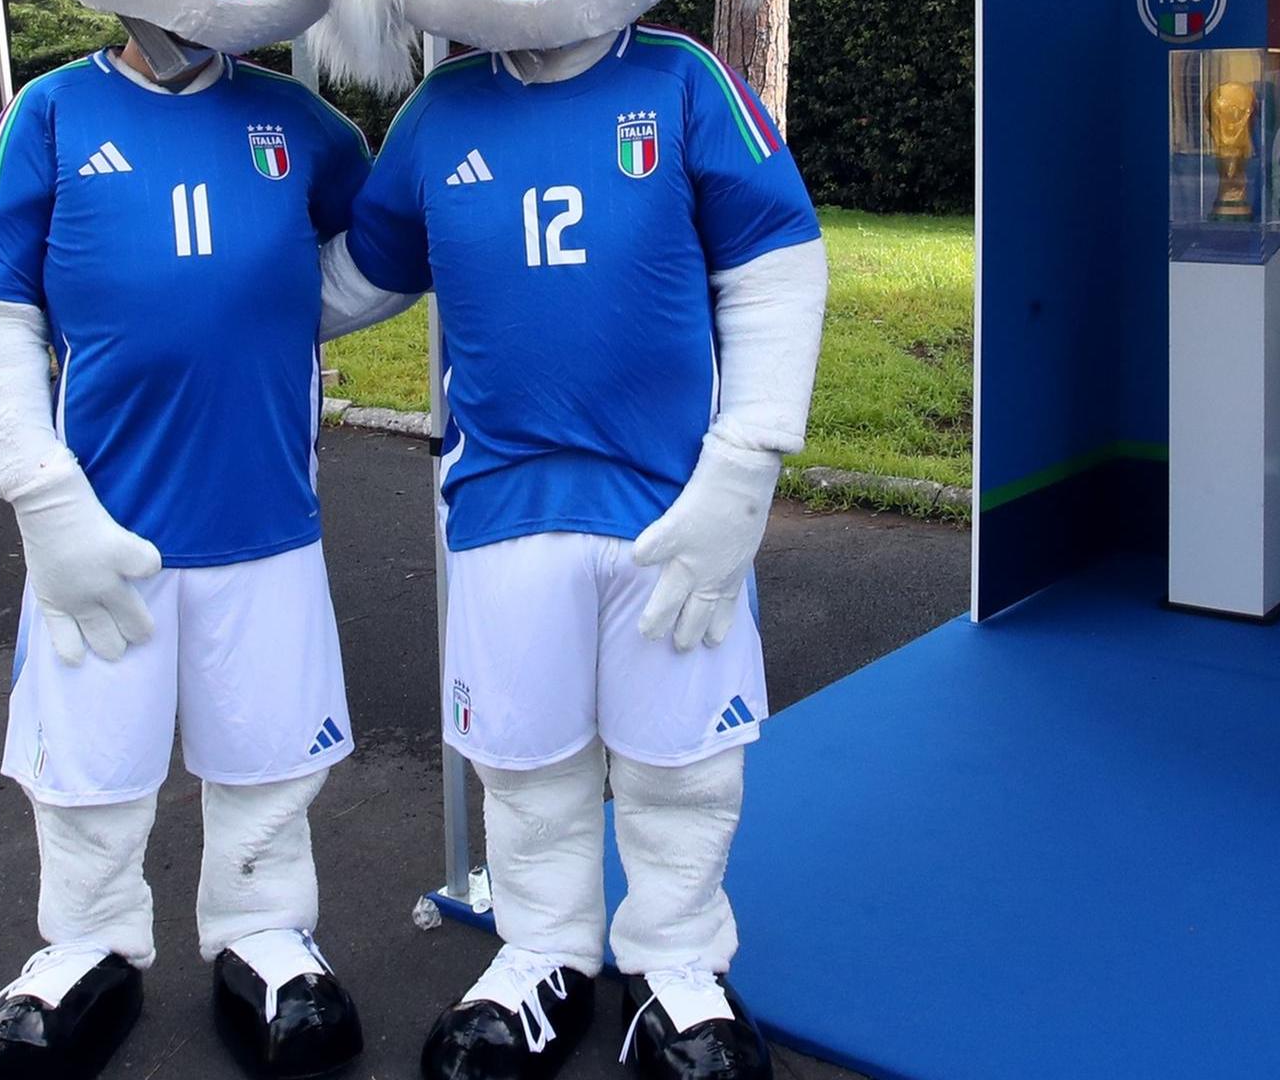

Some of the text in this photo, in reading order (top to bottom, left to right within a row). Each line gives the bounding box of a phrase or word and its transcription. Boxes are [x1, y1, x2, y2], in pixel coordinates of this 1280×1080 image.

[251, 136, 283, 146] ITALIA
[621, 125, 654, 138] ITALIA
[172, 182, 213, 257] 11
[522, 184, 587, 267] 12
